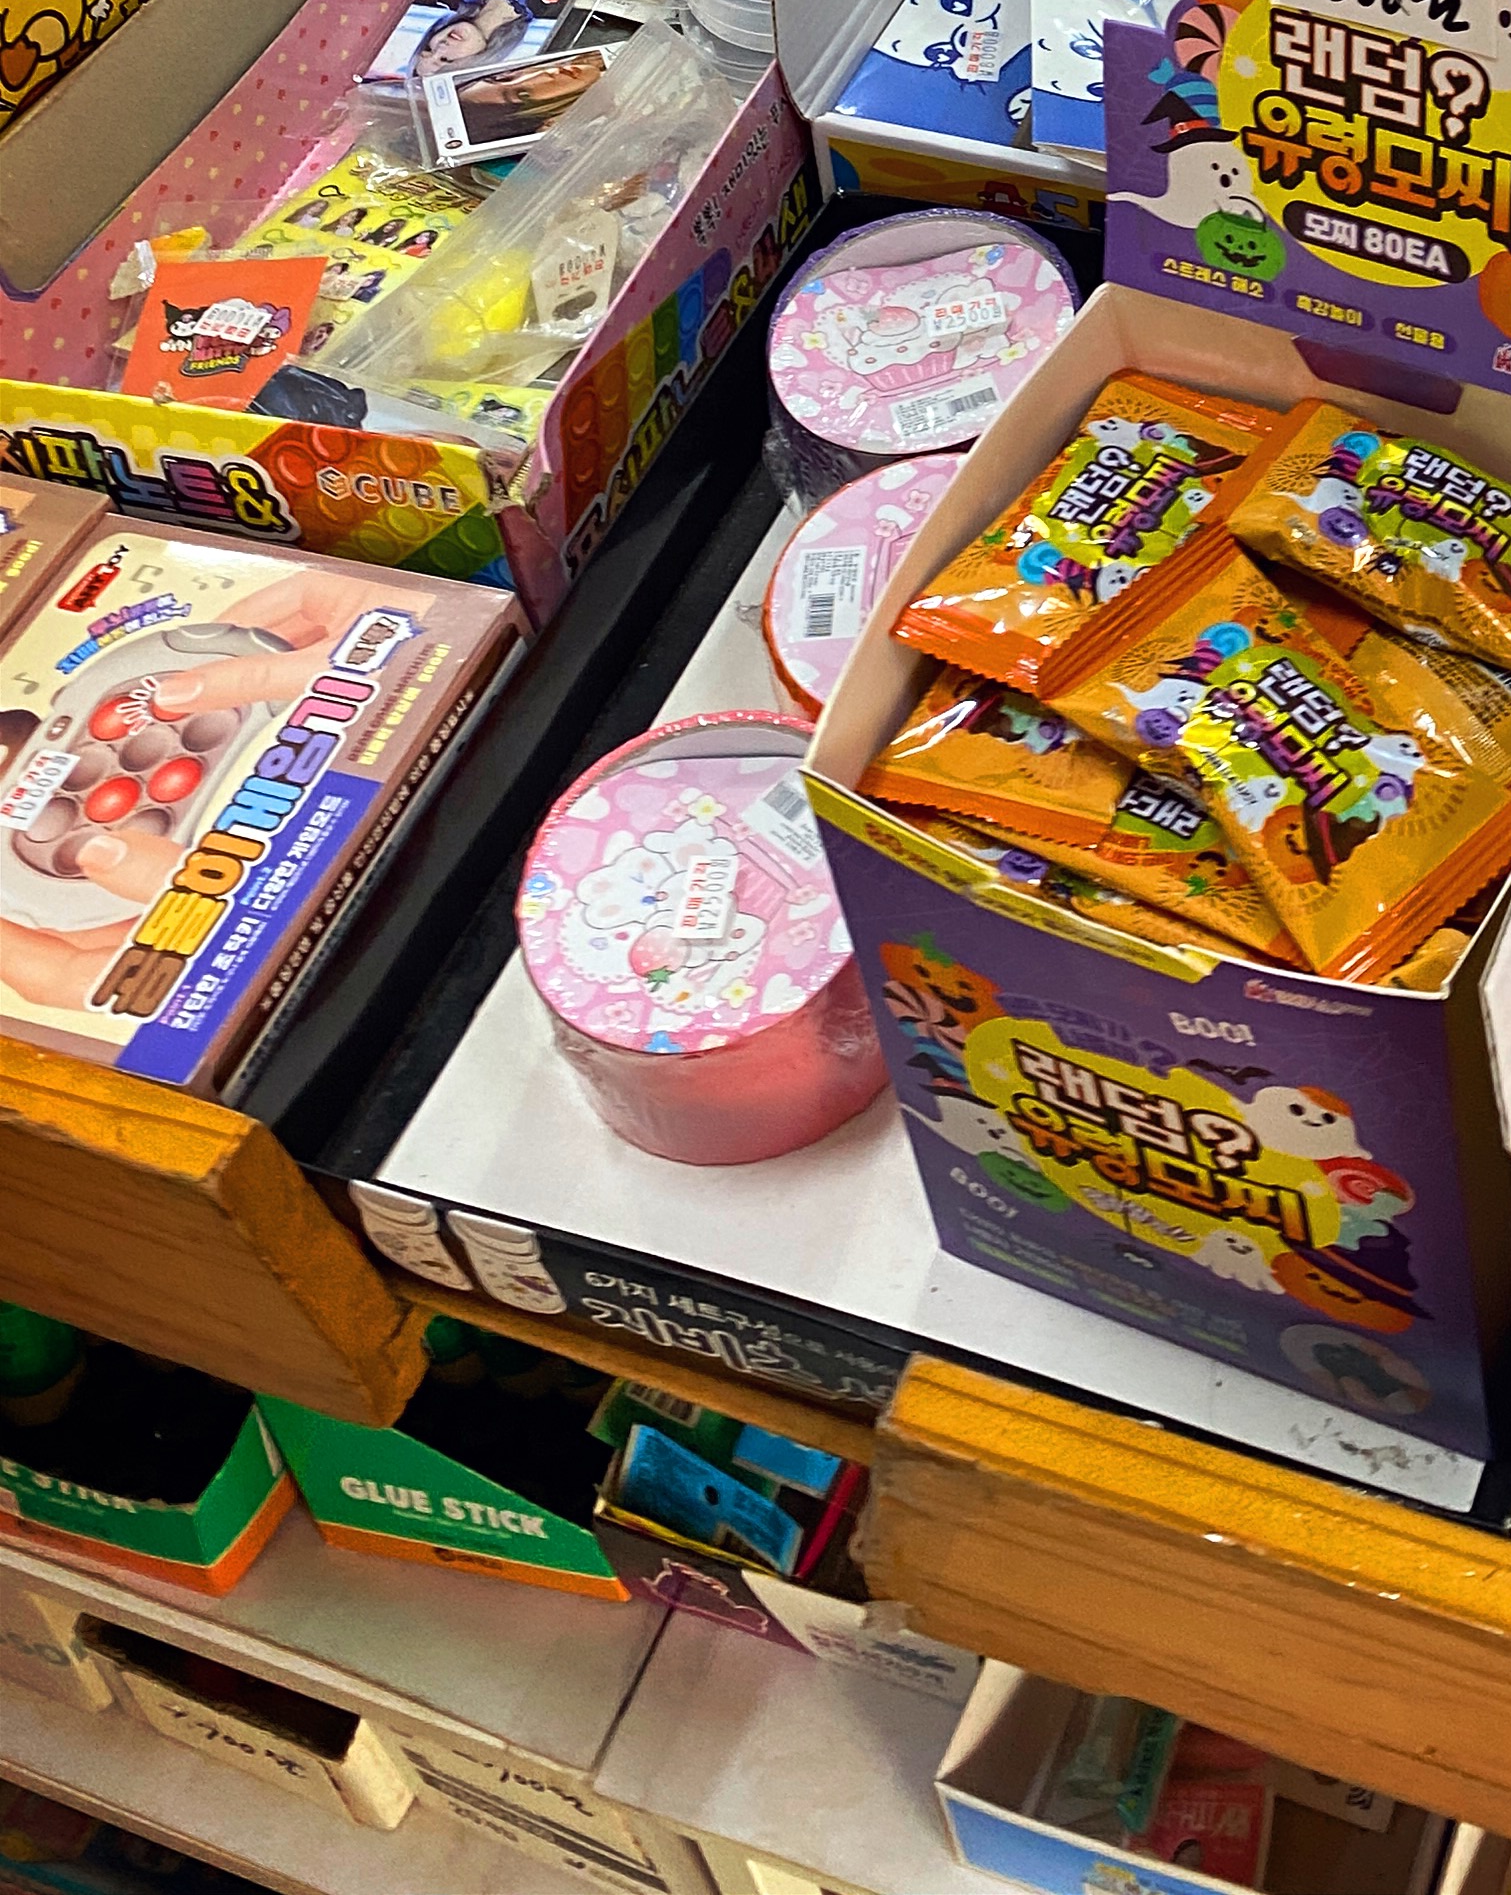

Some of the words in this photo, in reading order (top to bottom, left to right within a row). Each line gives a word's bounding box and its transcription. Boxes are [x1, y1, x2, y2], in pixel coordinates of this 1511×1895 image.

[967, 32, 984, 73] 판매가격
[1272, 9, 1488, 141] 랜덤?
[1303, 212, 1361, 249] 모찌
[1362, 224, 1452, 276] 80EA
[935, 297, 997, 319] 판매가격
[1161, 257, 1227, 288] 스트레스
[1230, 274, 1266, 300] 해소
[190, 354, 242, 371] FRIENDS
[1395, 321, 1447, 351] 선물용
[354, 472, 464, 517] CUBE
[1050, 447, 1140, 525] 랜덤?
[1088, 453, 1193, 560] 유령모찌
[1366, 476, 1511, 560] 유령모찌
[1255, 657, 1370, 755] 랜덤?
[90, 674, 376, 1017] 곰돌이게임기
[681, 862, 711, 928] 판매가격
[1168, 1011, 1257, 1048] BOO!
[1012, 1039, 1259, 1170] 랜덤?
[947, 1165, 1018, 1220] BOO!
[1007, 1092, 1316, 1249] 유령모찌
[341, 1474, 431, 1515] GLUE
[441, 1493, 549, 1542] STICK
